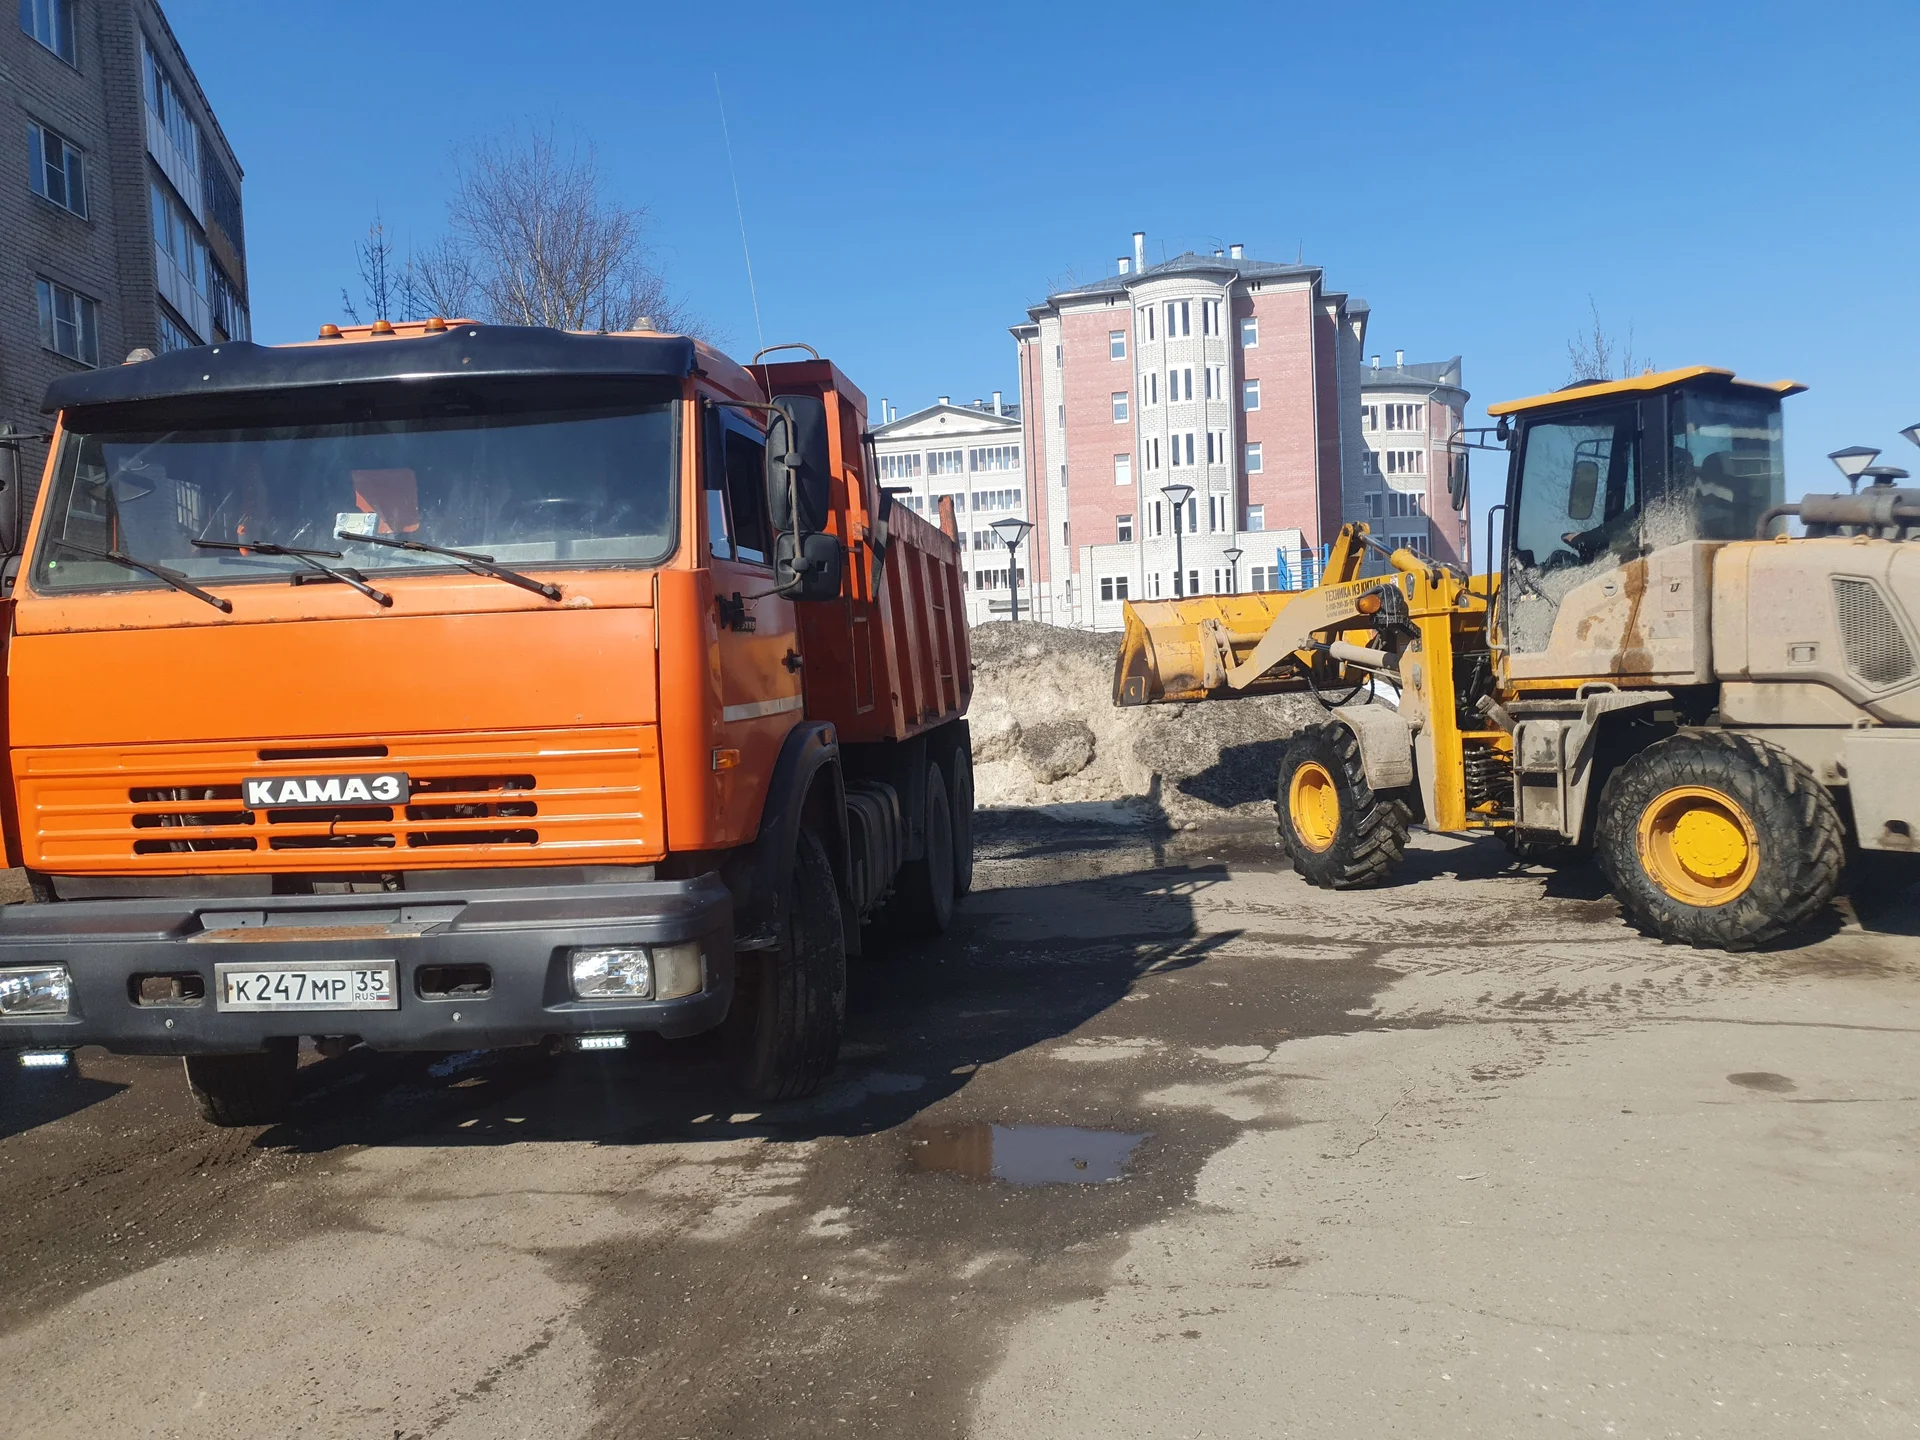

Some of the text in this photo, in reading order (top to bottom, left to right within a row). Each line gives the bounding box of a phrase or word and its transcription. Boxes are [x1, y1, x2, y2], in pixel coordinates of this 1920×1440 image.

[1325, 586, 1351, 602] ТЕХНИКА
[1352, 583, 1360, 596] ИЗ
[248, 776, 400, 804] КАМАЗ
[356, 971, 384, 991] 35
[355, 992, 375, 1000] RUS
